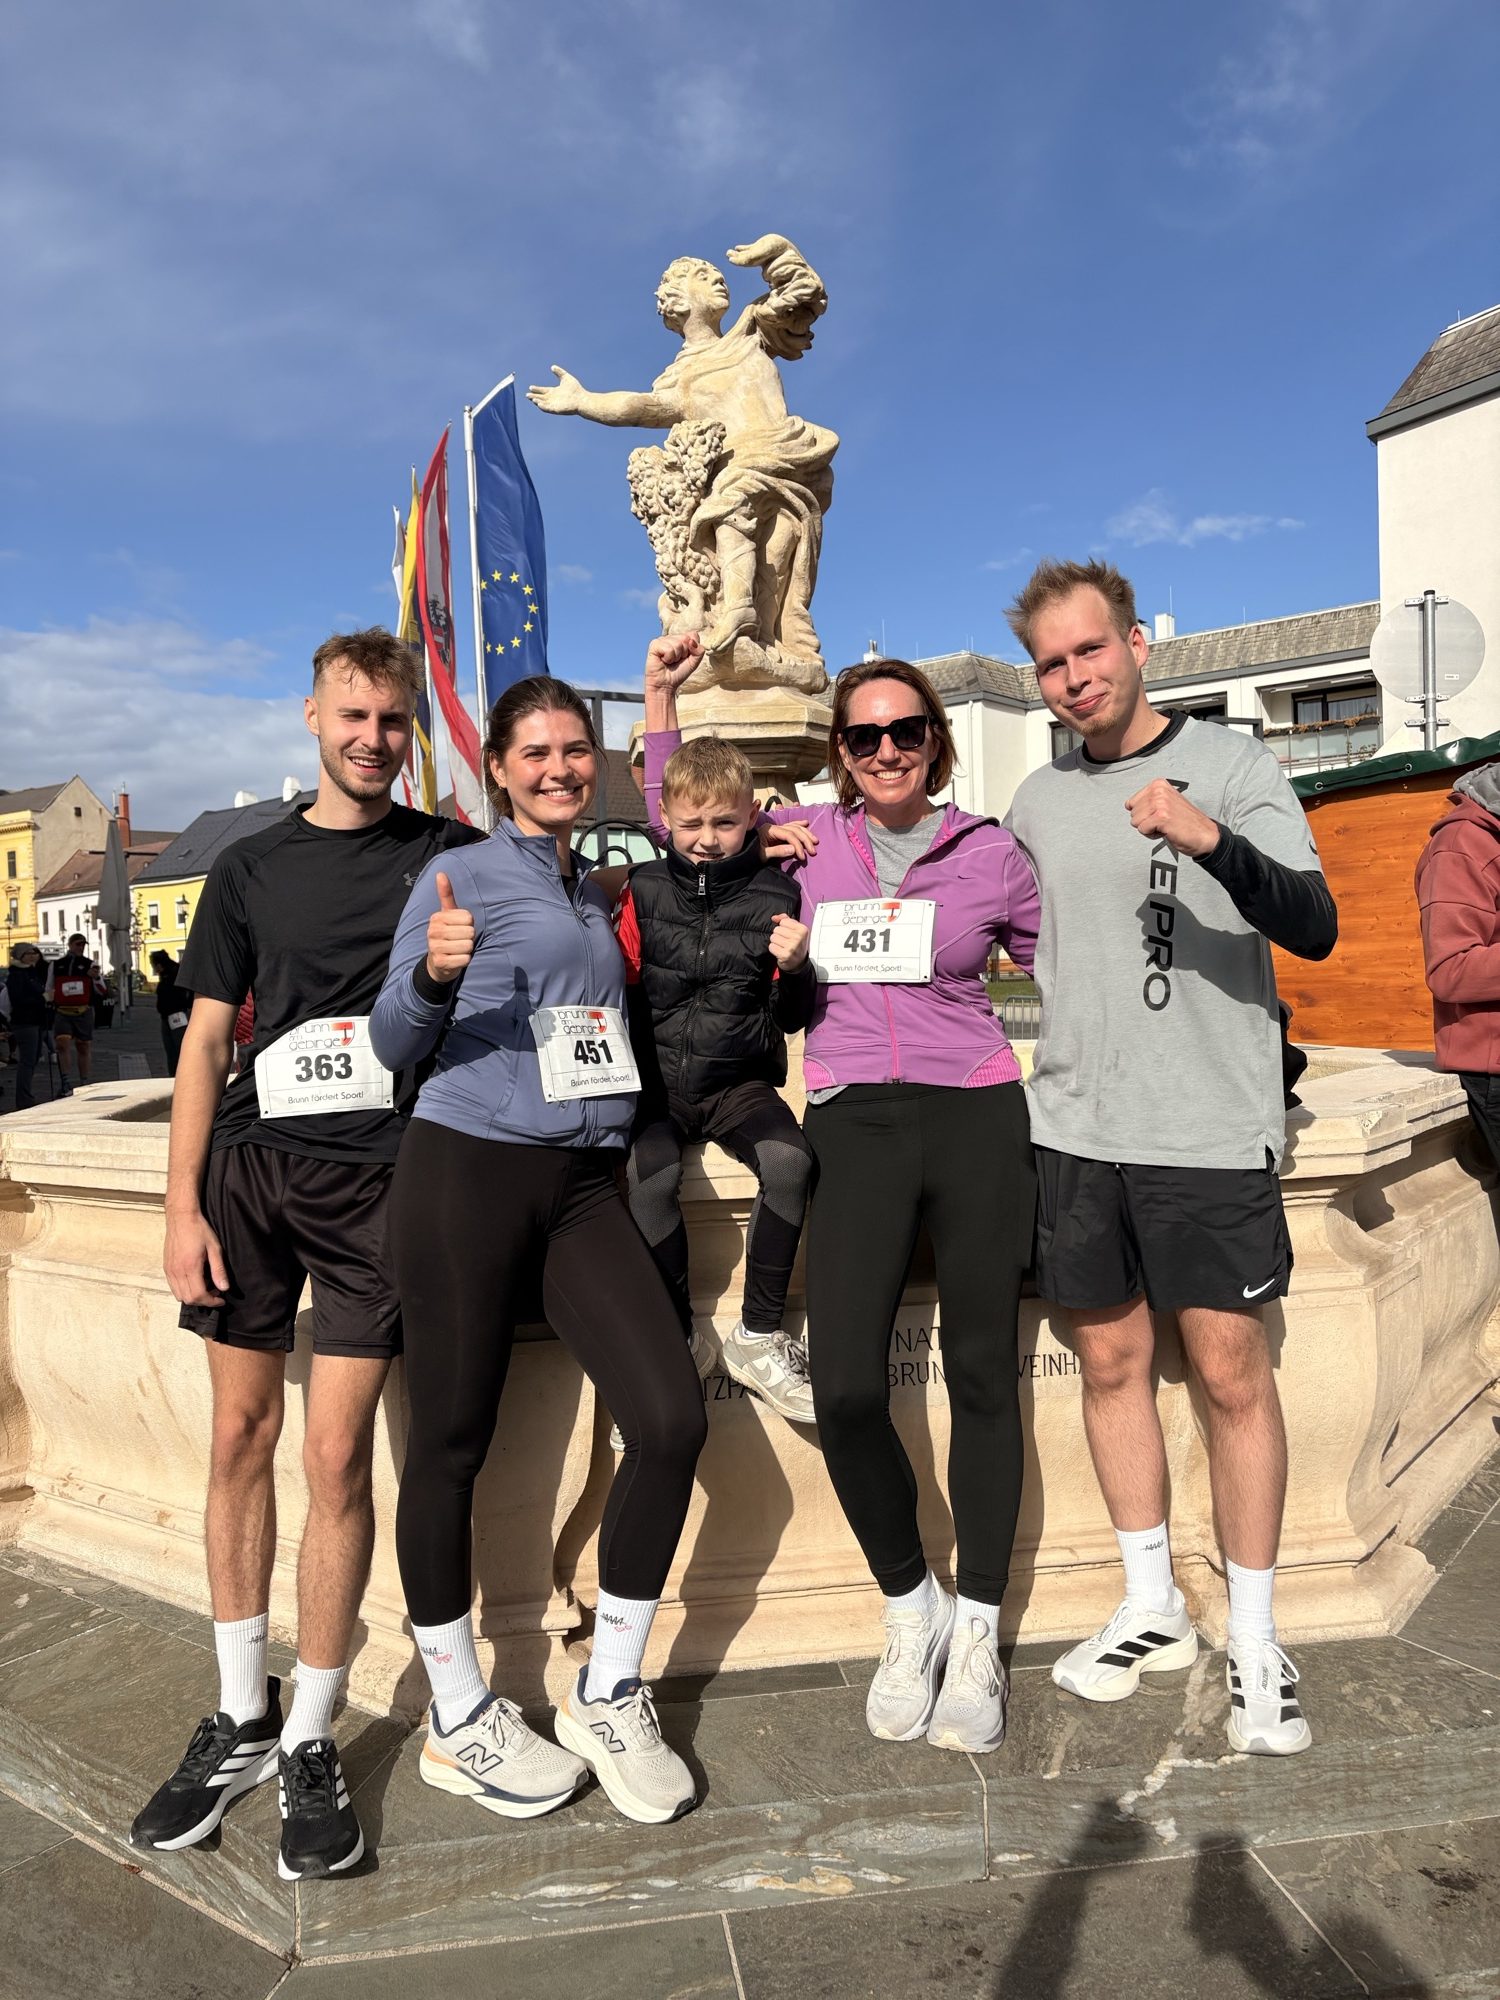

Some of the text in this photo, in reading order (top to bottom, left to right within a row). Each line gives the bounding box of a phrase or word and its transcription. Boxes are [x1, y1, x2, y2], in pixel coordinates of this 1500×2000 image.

[844, 903, 880, 911] brunn
[843, 928, 891, 953] 431
[1143, 900, 1176, 1012] PRO
[834, 964, 853, 972] Brunn
[289, 1037, 341, 1051] gebirge
[573, 1039, 614, 1065] 451
[295, 1052, 353, 1083] 363
[570, 1079, 590, 1088] Brunn
[287, 1096, 310, 1105] Brunn
[895, 1326, 943, 1353] NAT
